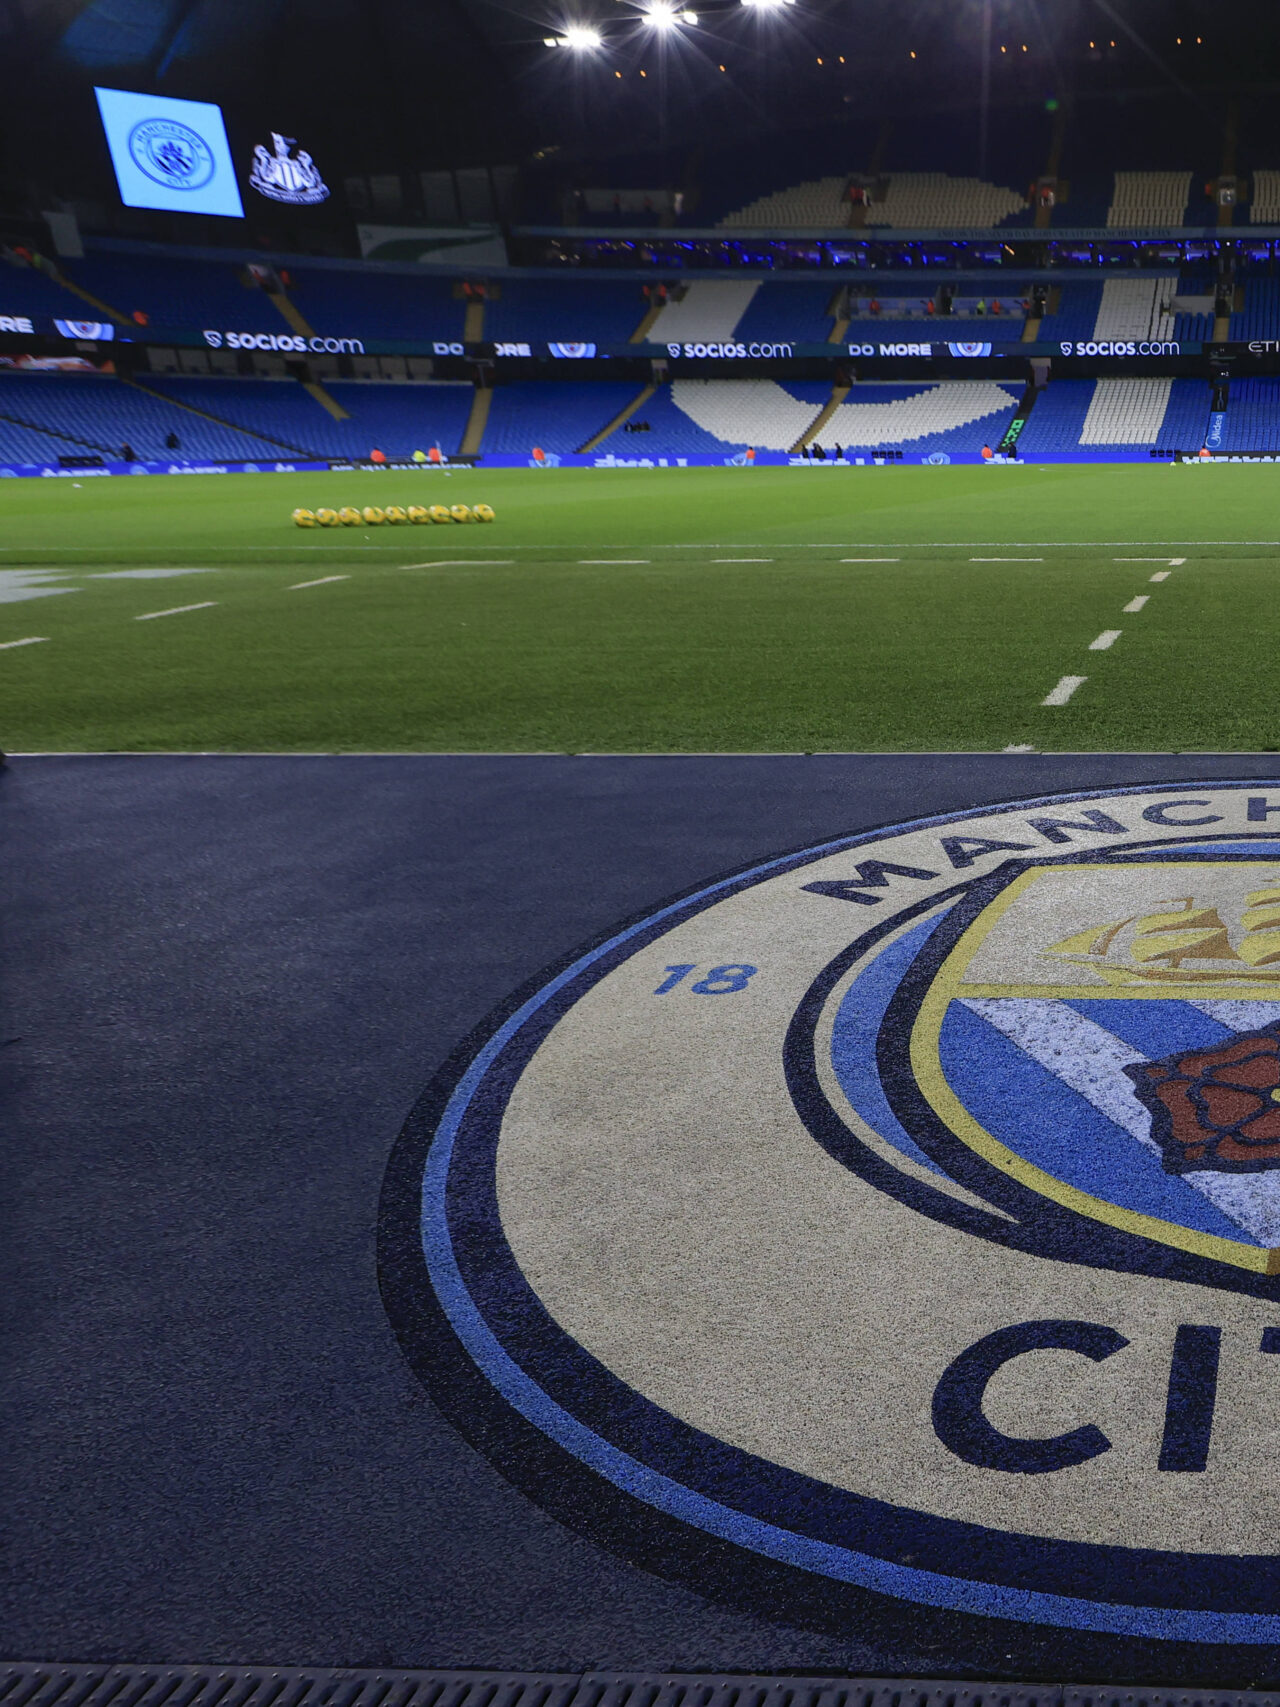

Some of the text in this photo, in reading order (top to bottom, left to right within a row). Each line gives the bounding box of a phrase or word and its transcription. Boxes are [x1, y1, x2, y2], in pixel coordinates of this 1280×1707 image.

[225, 331, 365, 354] SOCIOS.com
[432, 342, 464, 355] DO
[848, 343, 932, 356] DO MORE
[1076, 342, 1180, 356] SOCIOS.com
[684, 343, 792, 358] SOCIOS.com
[653, 964, 758, 995] 18
